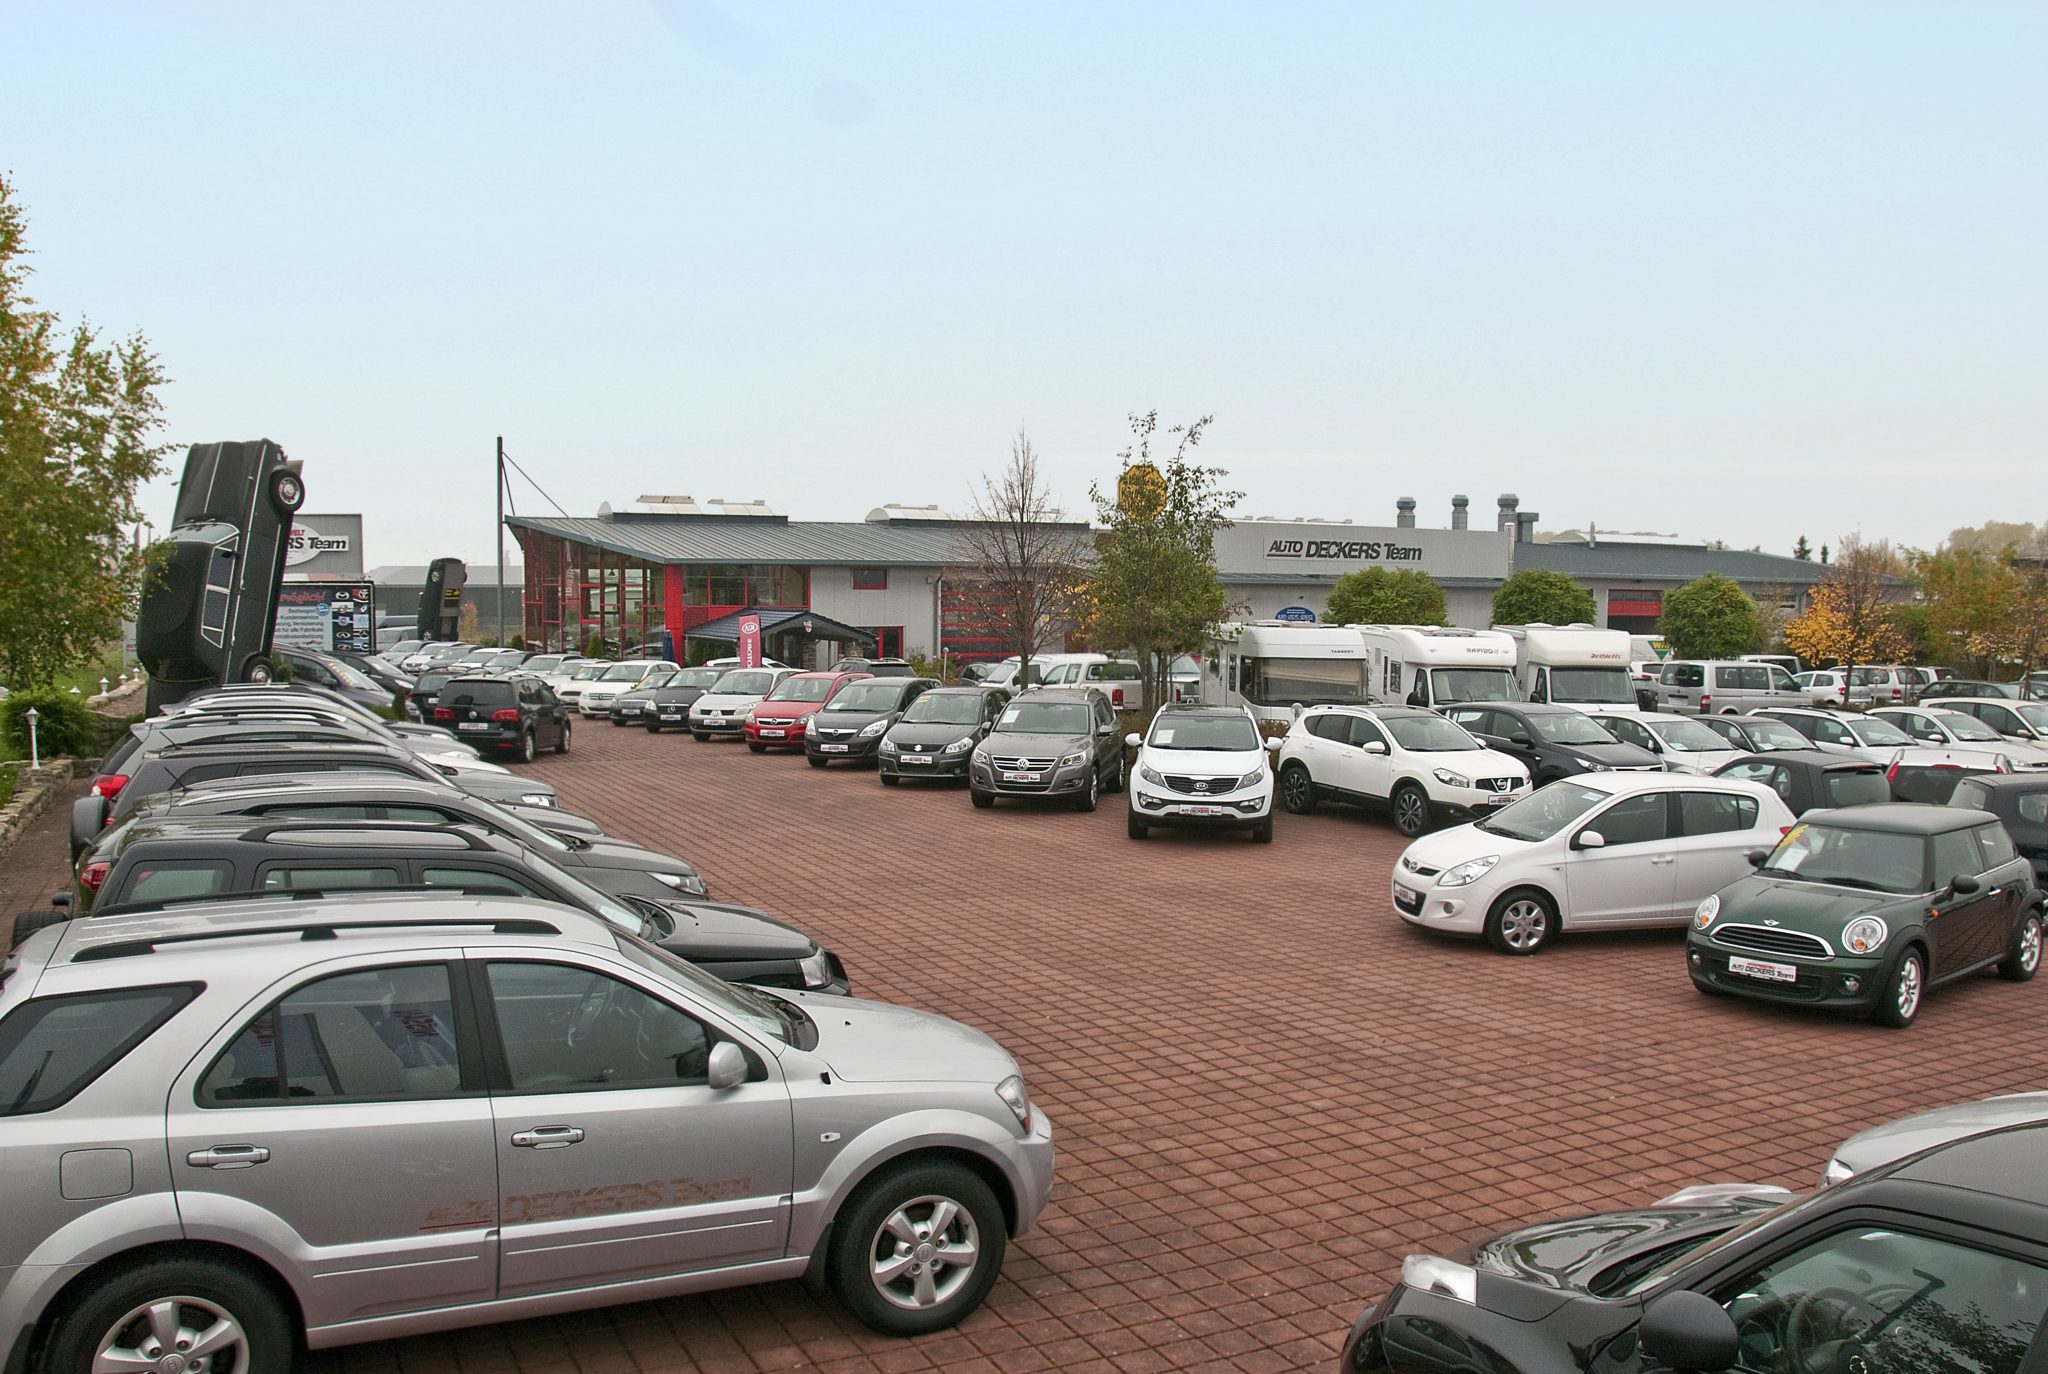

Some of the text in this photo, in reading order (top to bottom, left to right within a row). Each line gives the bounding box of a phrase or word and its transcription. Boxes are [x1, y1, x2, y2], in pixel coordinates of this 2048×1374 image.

[307, 537, 346, 549] Team
[1269, 540, 1422, 561] AUTO DECKERS Team
[1745, 965, 1775, 977] DECKERS
